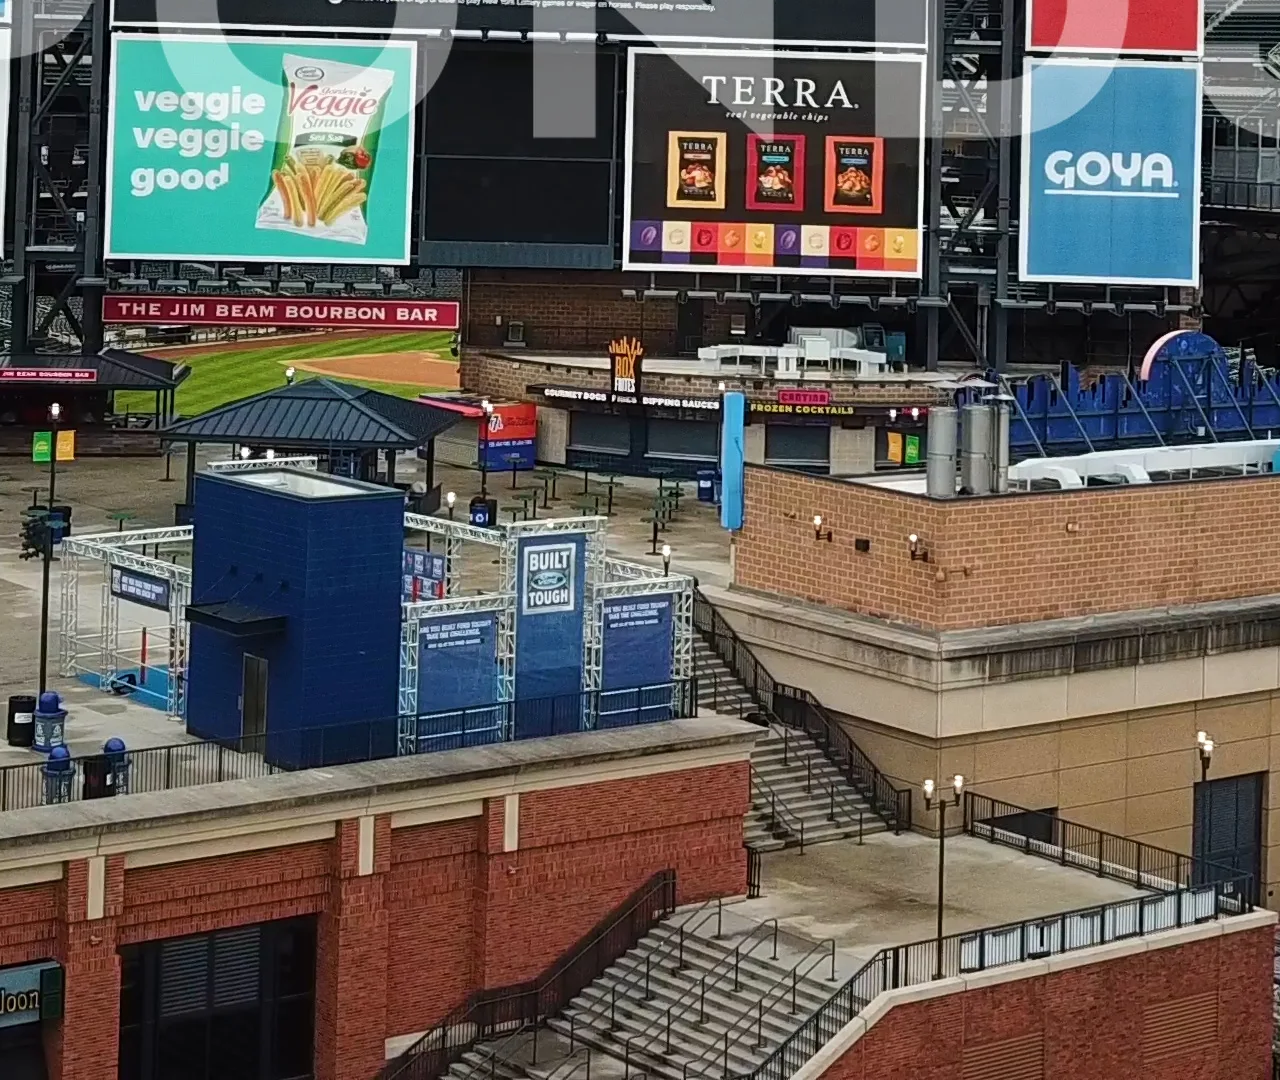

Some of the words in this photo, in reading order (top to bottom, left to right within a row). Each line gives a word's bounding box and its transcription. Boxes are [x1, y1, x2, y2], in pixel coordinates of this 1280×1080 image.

[289, 81, 378, 118] Veggie
[702, 75, 854, 109] TERRA
[134, 85, 267, 121] veggie
[725, 109, 748, 119] real
[750, 111, 799, 123] vegetable
[801, 112, 829, 124] chips
[132, 123, 265, 158] veggie
[682, 141, 713, 151] TERRA
[760, 144, 792, 153] TERRA
[839, 147, 870, 156] TERRA
[1044, 150, 1174, 189] GOYA
[130, 163, 230, 198] good
[118, 302, 162, 317] THE
[169, 303, 207, 318] JIM
[216, 304, 274, 319] BEAM
[285, 305, 387, 321] BOURBON
[396, 306, 438, 322] BAR
[615, 354, 635, 378] BOX
[544, 388, 584, 400] GOURMET
[583, 392, 607, 402] DOGS
[642, 396, 681, 407] DIPPING
[681, 400, 720, 410] SAUCES
[750, 403, 793, 414] FROZEN
[796, 405, 855, 415] COCKTAILS
[529, 551, 570, 572] BUILT
[529, 589, 569, 606] TOUGH
